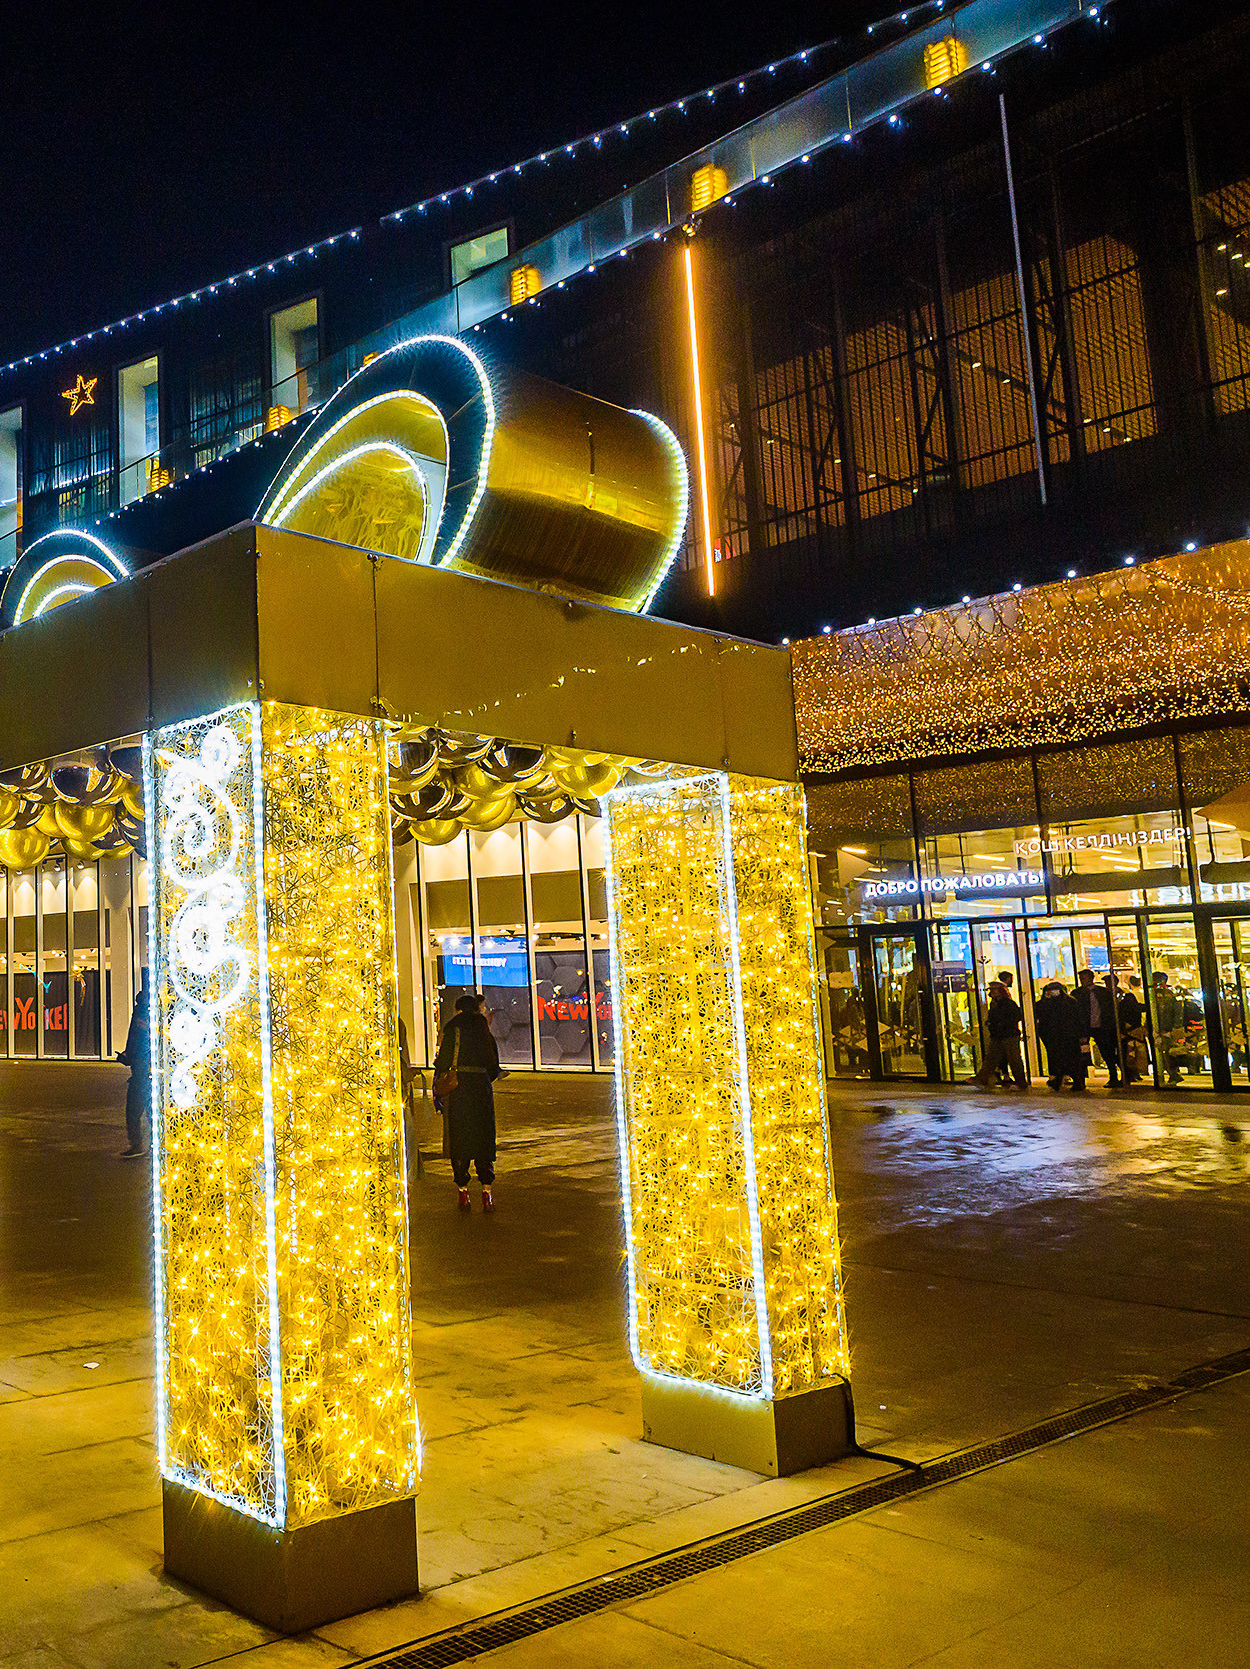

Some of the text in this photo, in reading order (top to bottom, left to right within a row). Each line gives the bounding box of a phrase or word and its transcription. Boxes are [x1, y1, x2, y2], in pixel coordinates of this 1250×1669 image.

[1015, 839, 1060, 856] ҚОШ
[865, 871, 1045, 898] ДОБРО ПОЖАЛОВАТЬ!
